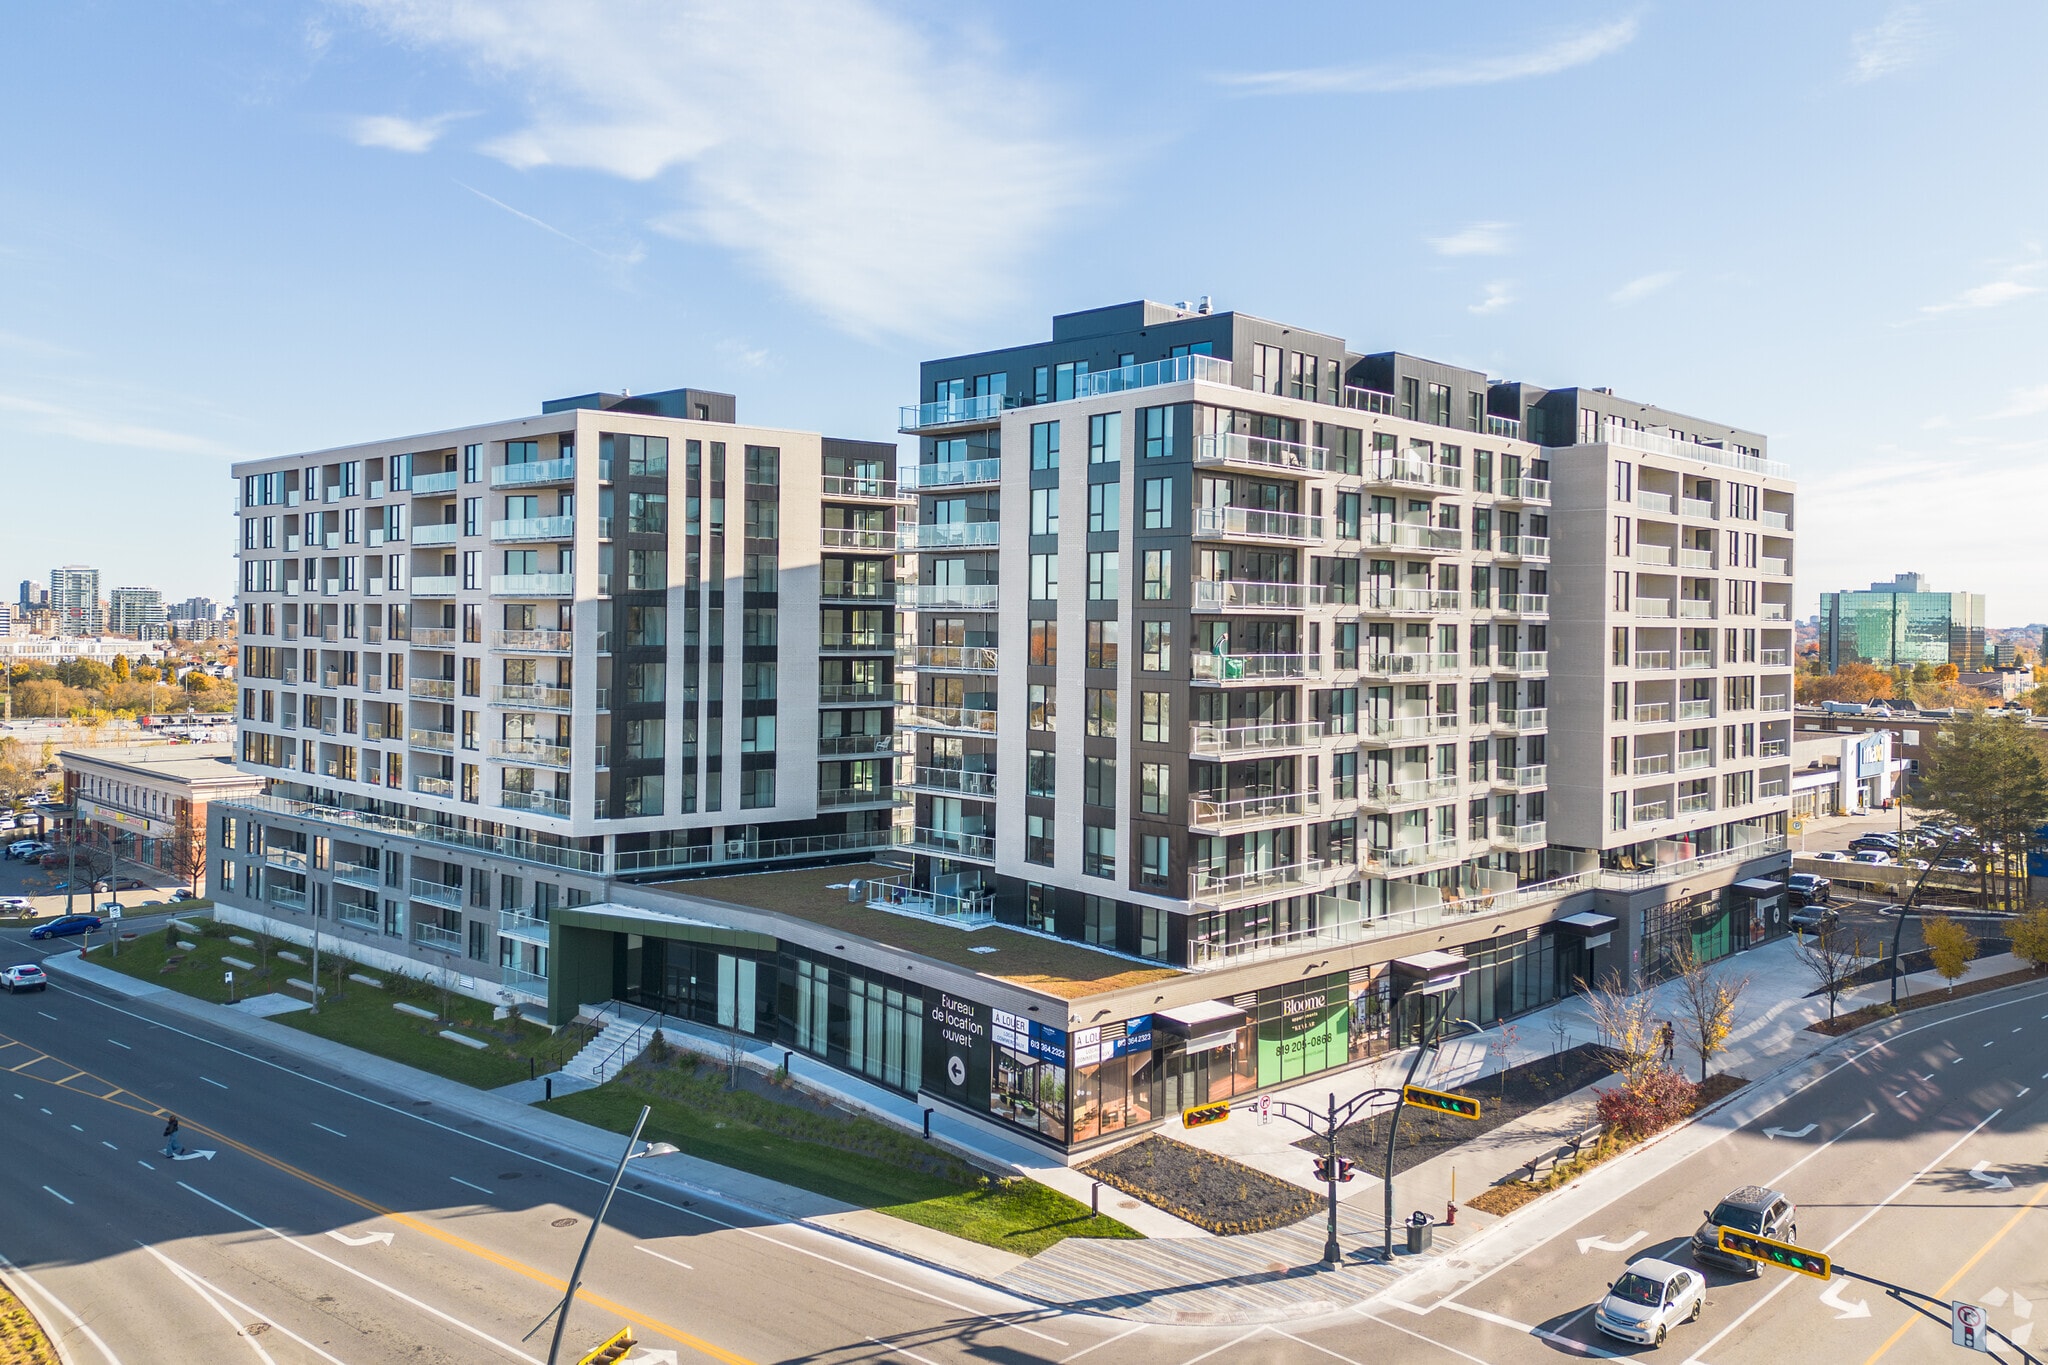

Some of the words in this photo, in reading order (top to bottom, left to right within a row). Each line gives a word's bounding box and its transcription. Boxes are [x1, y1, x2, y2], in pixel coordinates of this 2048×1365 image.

[942, 994, 974, 1016] Bureau
[1283, 995, 1325, 1015] Bloome
[932, 1007, 944, 1021] de
[945, 1010, 983, 1036] location
[943, 1029, 972, 1048] ouvert
[1276, 1044, 1290, 1056] 819
